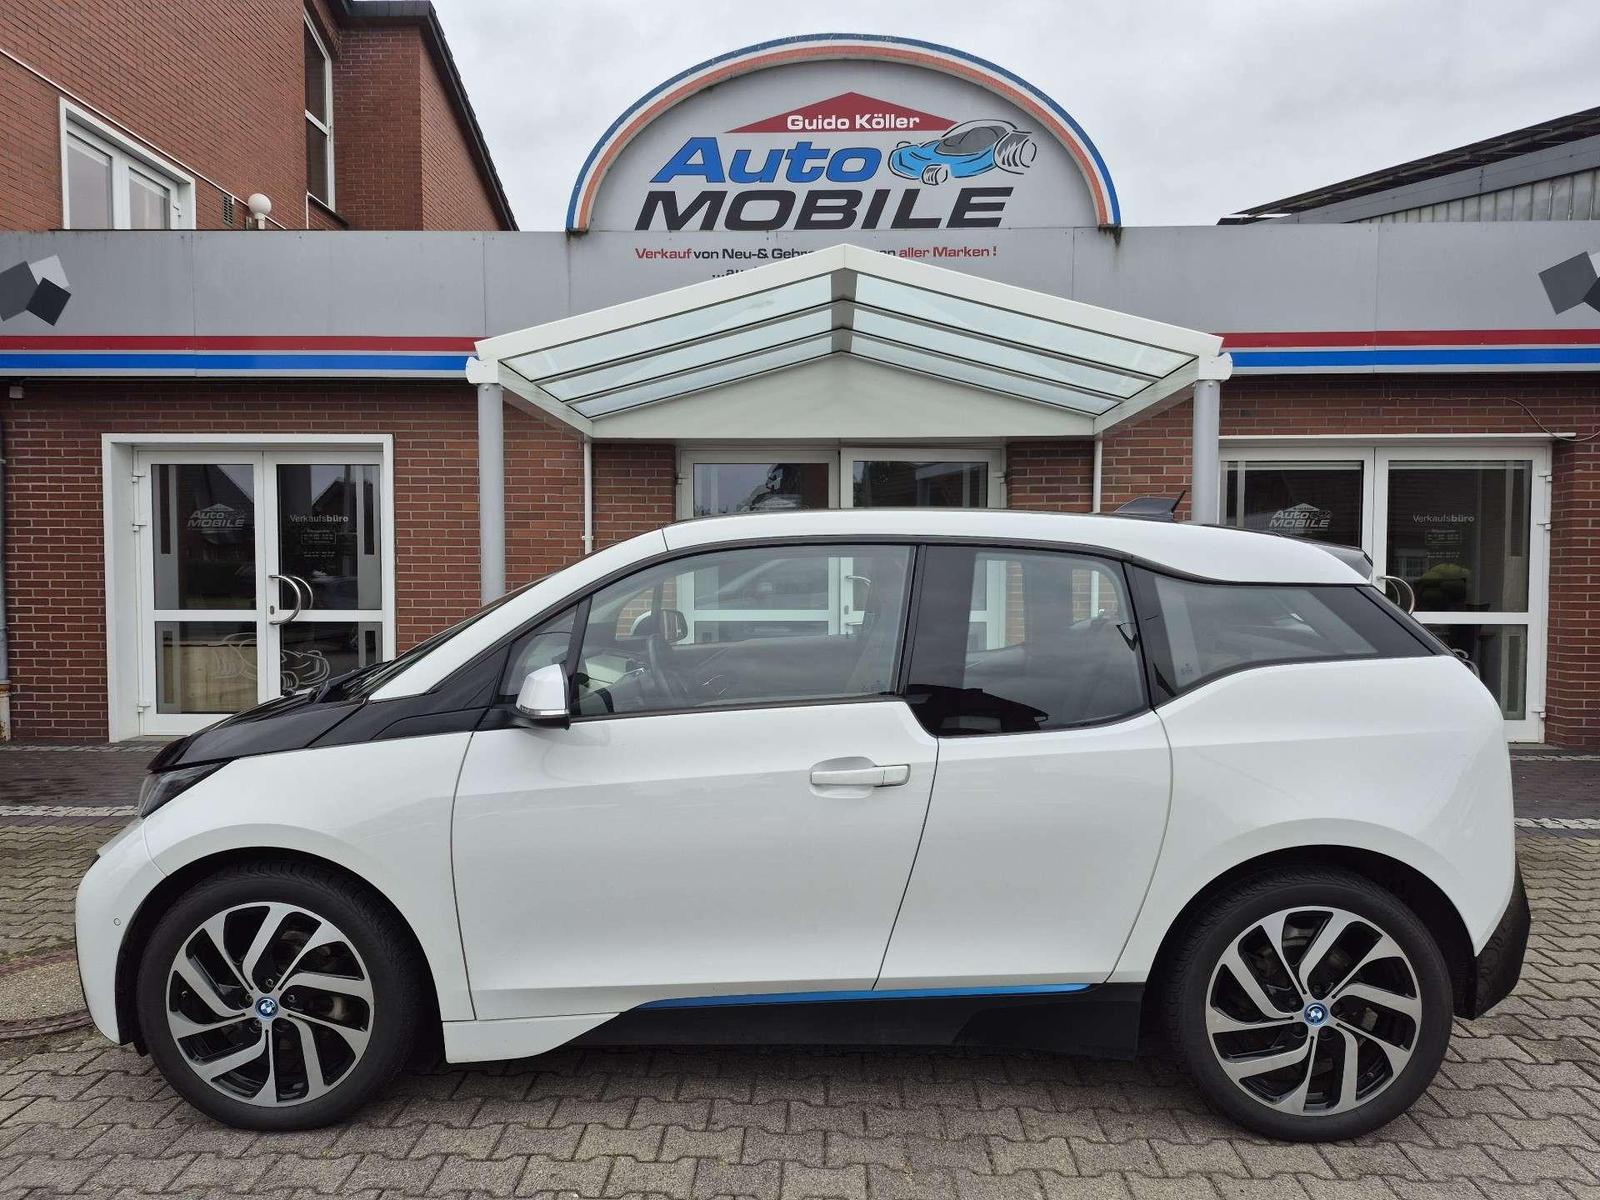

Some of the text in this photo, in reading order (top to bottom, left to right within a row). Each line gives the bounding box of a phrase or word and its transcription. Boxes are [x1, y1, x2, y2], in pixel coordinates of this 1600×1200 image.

[786, 113, 920, 131] Guido Köller
[649, 136, 883, 184] Auto
[634, 186, 1014, 231] MOBILE
[635, 247, 692, 260] Verkauf
[693, 250, 719, 260] von
[899, 247, 930, 259] aller
[932, 246, 990, 258] Marken
[190, 510, 225, 519] Auto
[289, 514, 350, 523] Verkaufsbüro
[1271, 510, 1310, 519] Auto
[1412, 514, 1475, 523] Verkaufsbüro
[186, 519, 246, 528] MOBILE
[1269, 519, 1330, 528] MOBILE
